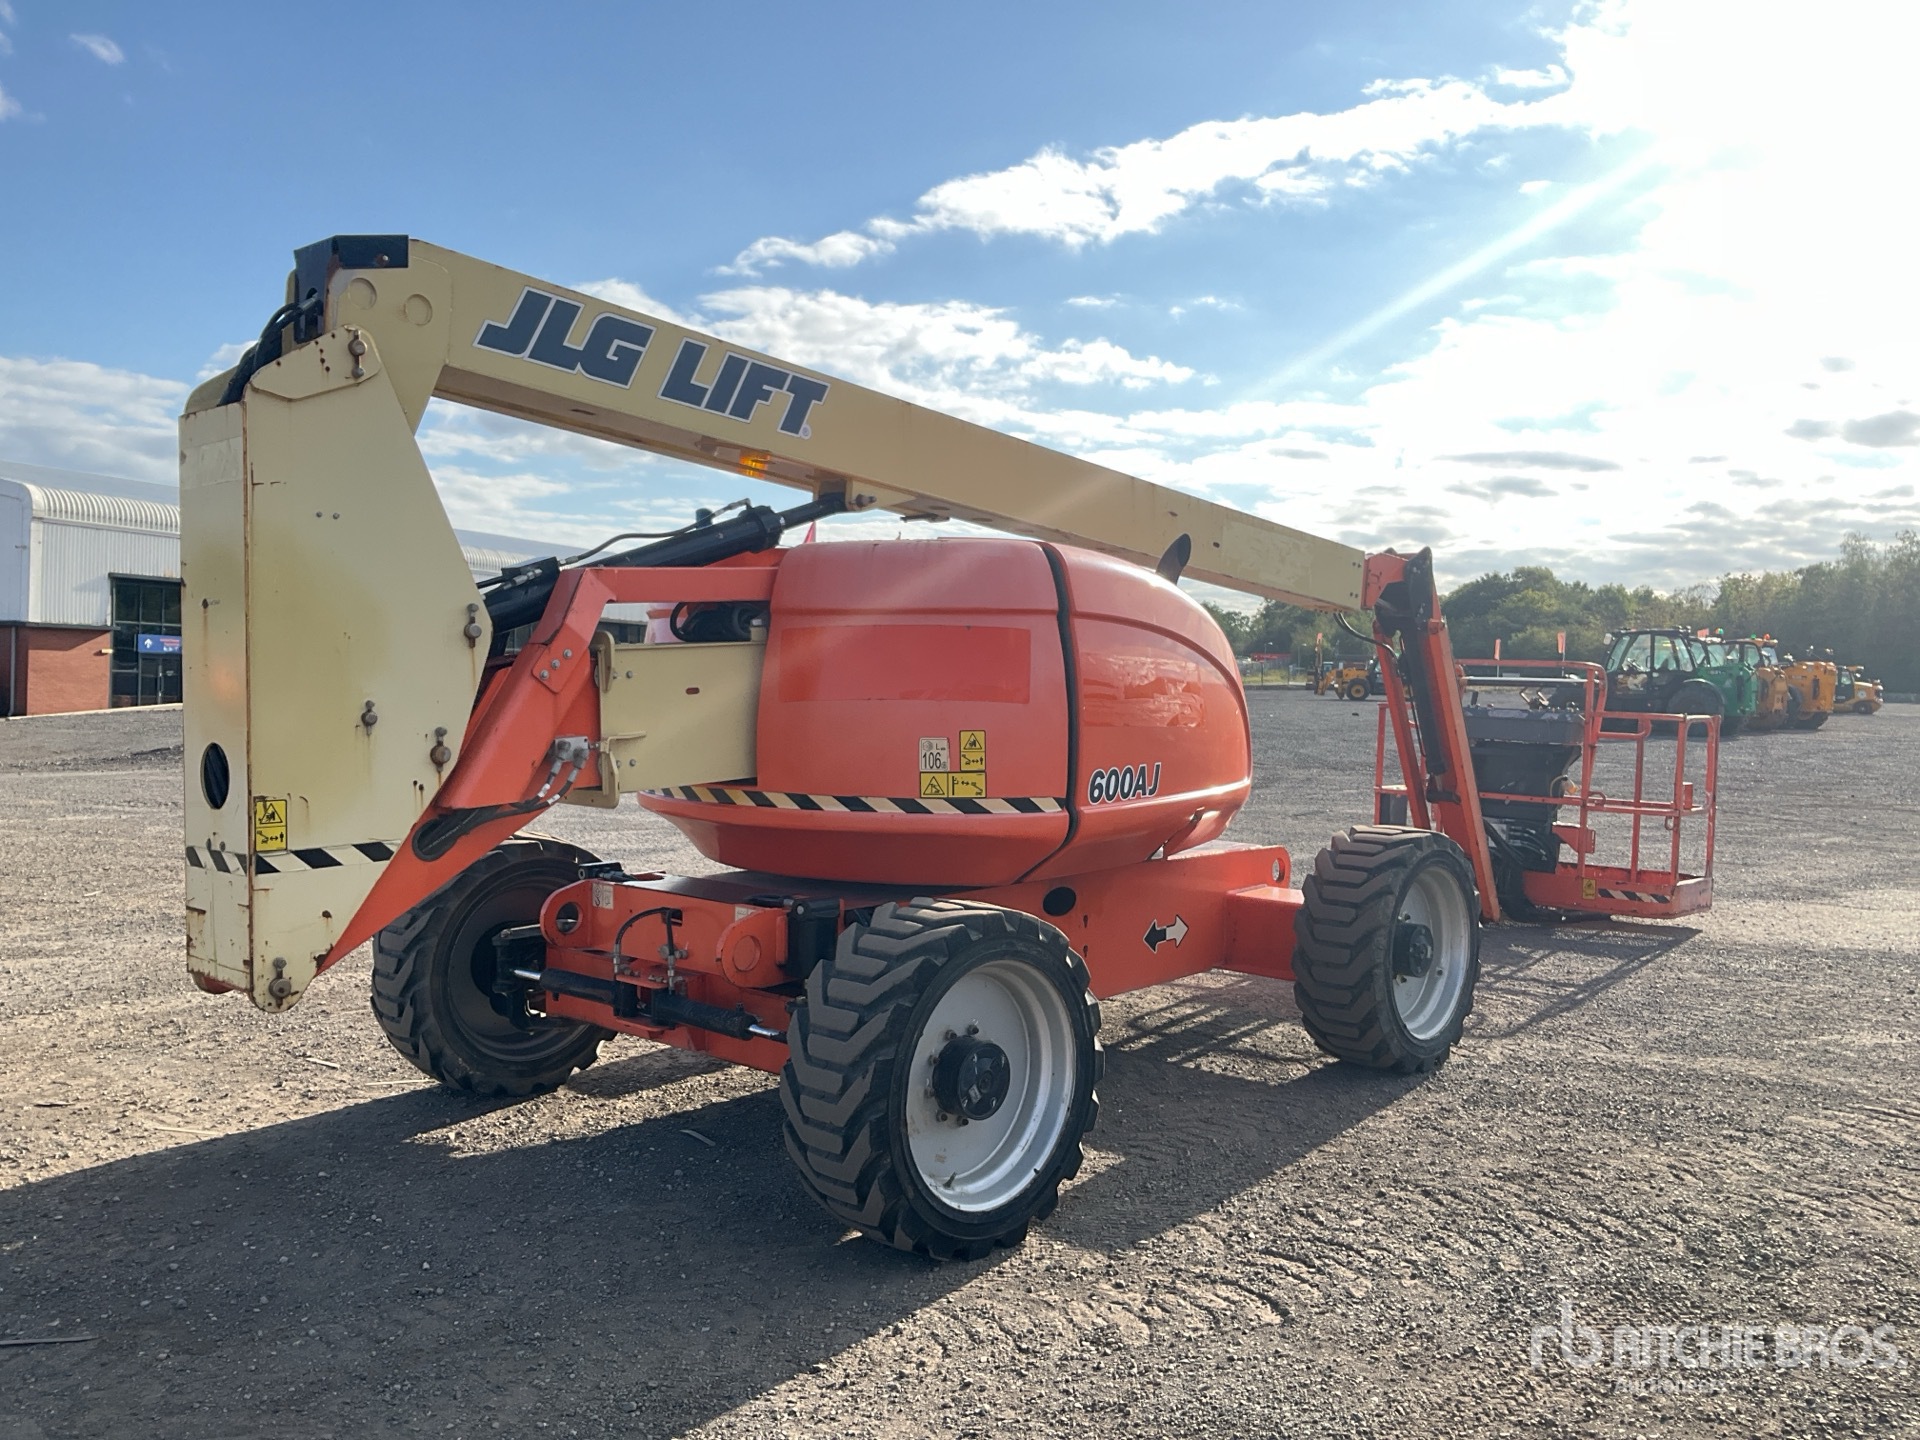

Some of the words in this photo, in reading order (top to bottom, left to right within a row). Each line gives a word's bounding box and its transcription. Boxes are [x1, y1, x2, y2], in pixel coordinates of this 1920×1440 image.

[473, 286, 657, 389] JLG
[922, 751, 942, 770] 106
[1088, 762, 1162, 805] 600AJ
